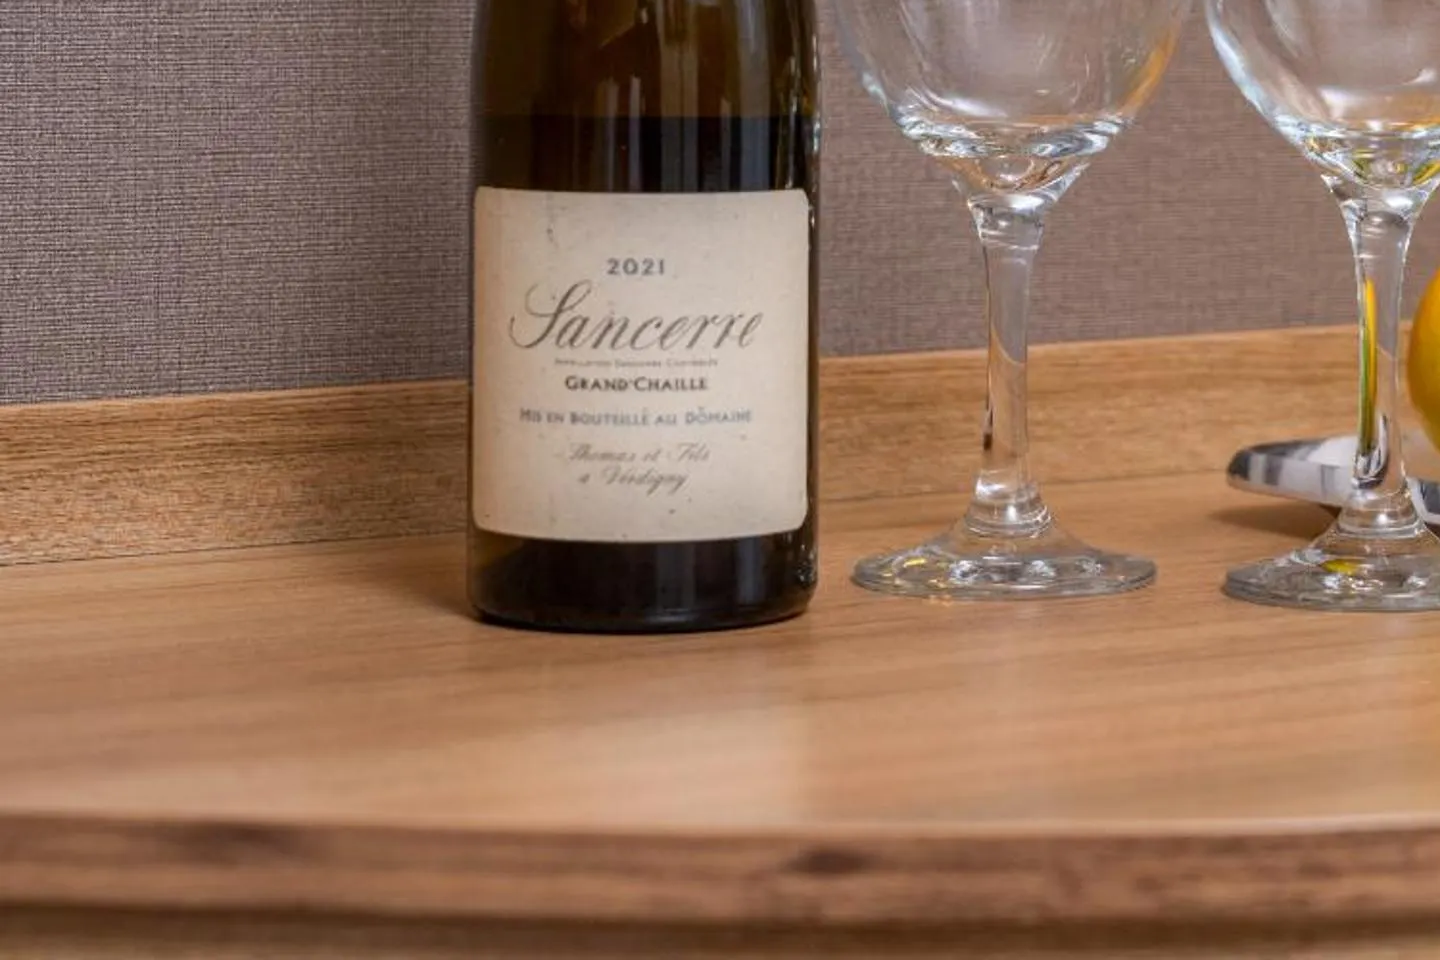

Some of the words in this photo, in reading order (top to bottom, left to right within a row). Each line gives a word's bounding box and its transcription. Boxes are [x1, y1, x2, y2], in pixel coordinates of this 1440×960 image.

[606, 258, 665, 275] 2021
[508, 278, 764, 351] Sancerre
[519, 407, 542, 424] MIS
[547, 411, 565, 423] EN
[654, 414, 677, 427] AU
